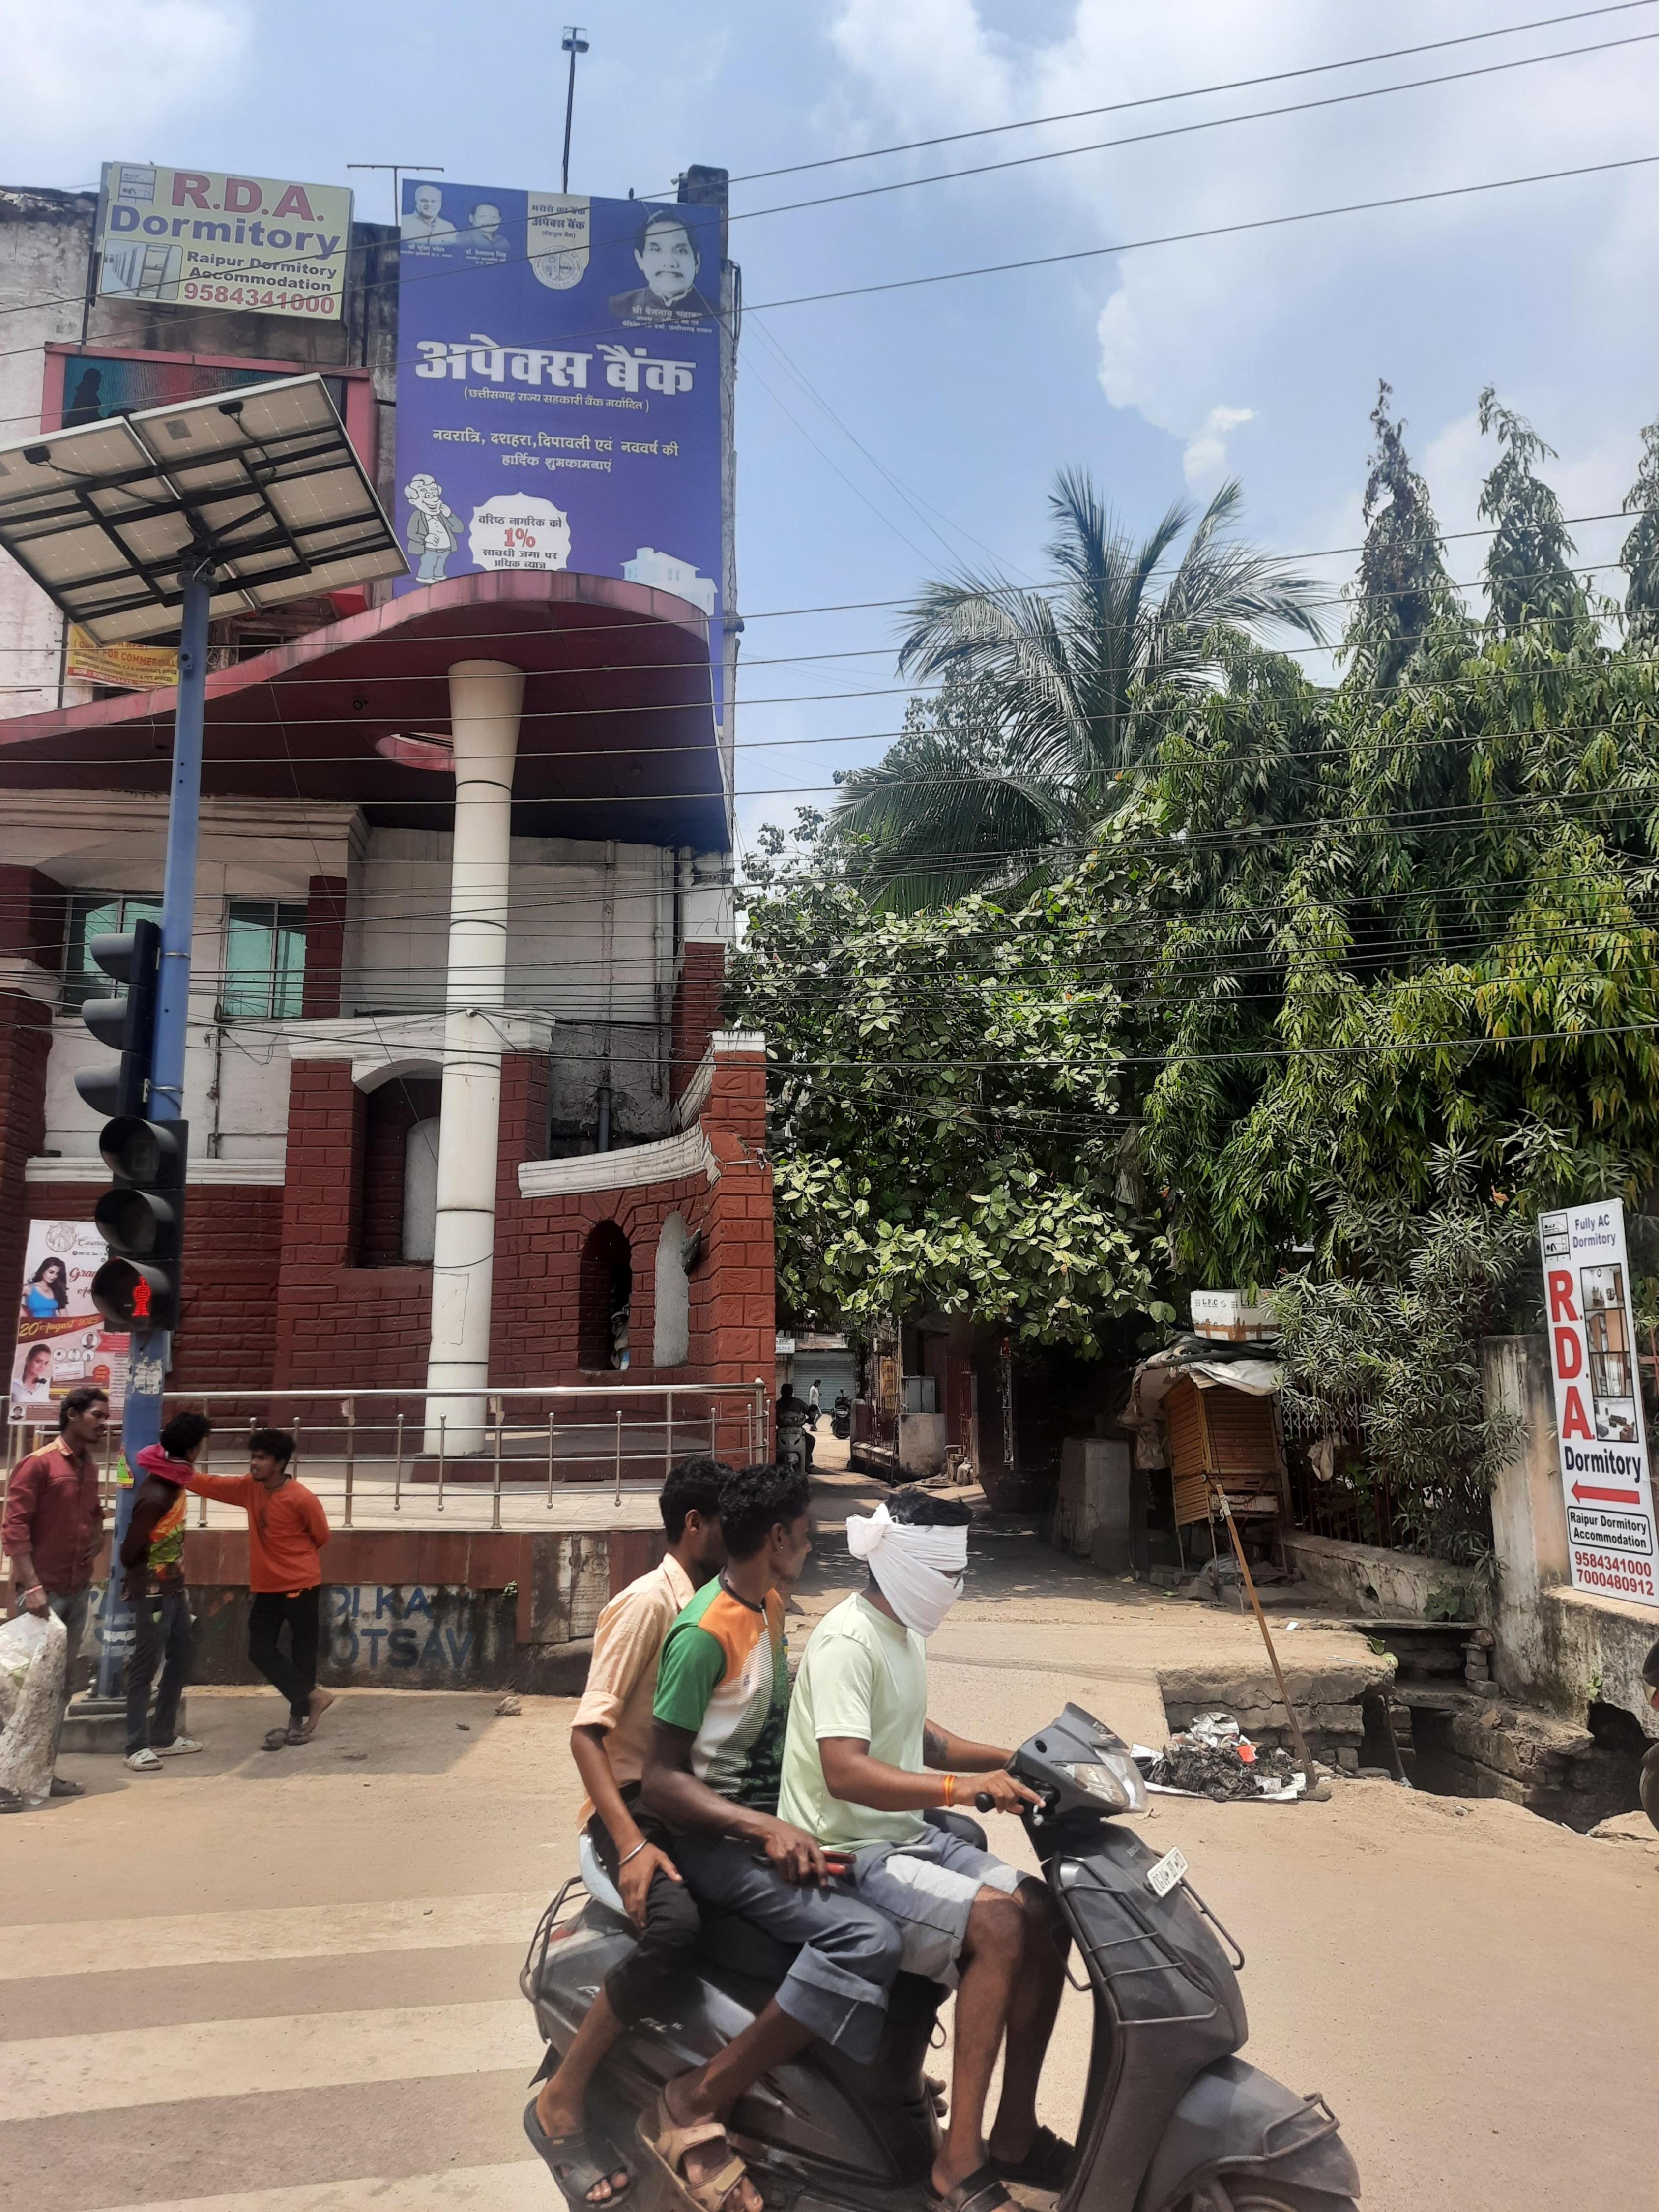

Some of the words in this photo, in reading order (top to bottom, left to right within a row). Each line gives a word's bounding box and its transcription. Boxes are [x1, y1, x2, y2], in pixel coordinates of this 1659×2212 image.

[172, 172, 324, 221] R.D.A.
[110, 204, 341, 260] Dormitory
[187, 251, 244, 267] Raipur
[250, 257, 337, 279] Dormitory
[189, 267, 331, 291] Accommodation
[184, 282, 335, 314] 9584341000
[416, 334, 593, 388] अपेक्स
[596, 344, 696, 395] बैंक
[518, 392, 541, 403] राज्य
[543, 393, 583, 406] सहकारी
[586, 395, 604, 407] बैंक
[433, 427, 485, 445] नवरात्रि,
[491, 433, 536, 448] दशहरा,
[538, 432, 590, 449] दिपावली
[595, 437, 612, 452] एवं
[621, 439, 658, 454] नववर्ष
[663, 442, 678, 456] की
[502, 453, 539, 466] हार्दिक
[545, 454, 611, 473] शुभकामनाएं
[478, 513, 505, 525] वरिष्ठ
[509, 515, 545, 527] नागरिक
[549, 517, 562, 528] को
[504, 528, 536, 547] 1%
[482, 547, 515, 558] सावधी
[519, 550, 540, 559] जमा
[545, 551, 558, 560] पर
[493, 559, 520, 569] अधिक
[102, 649, 119, 659] FOR
[121, 652, 176, 667] COMMERCIAL
[1575, 1217, 1595, 1232] Fully
[1598, 1214, 1610, 1226] AC
[1572, 1232, 1616, 1249] Dormitory
[1565, 1446, 1641, 1483] Dormitory
[1571, 1512, 1598, 1526] Raipur
[1601, 1515, 1646, 1535] Dormitory
[1574, 1527, 1646, 1548] Accommodation
[1575, 1551, 1651, 1577] 9584341000
[1576, 1569, 1654, 1596] 7000480912
